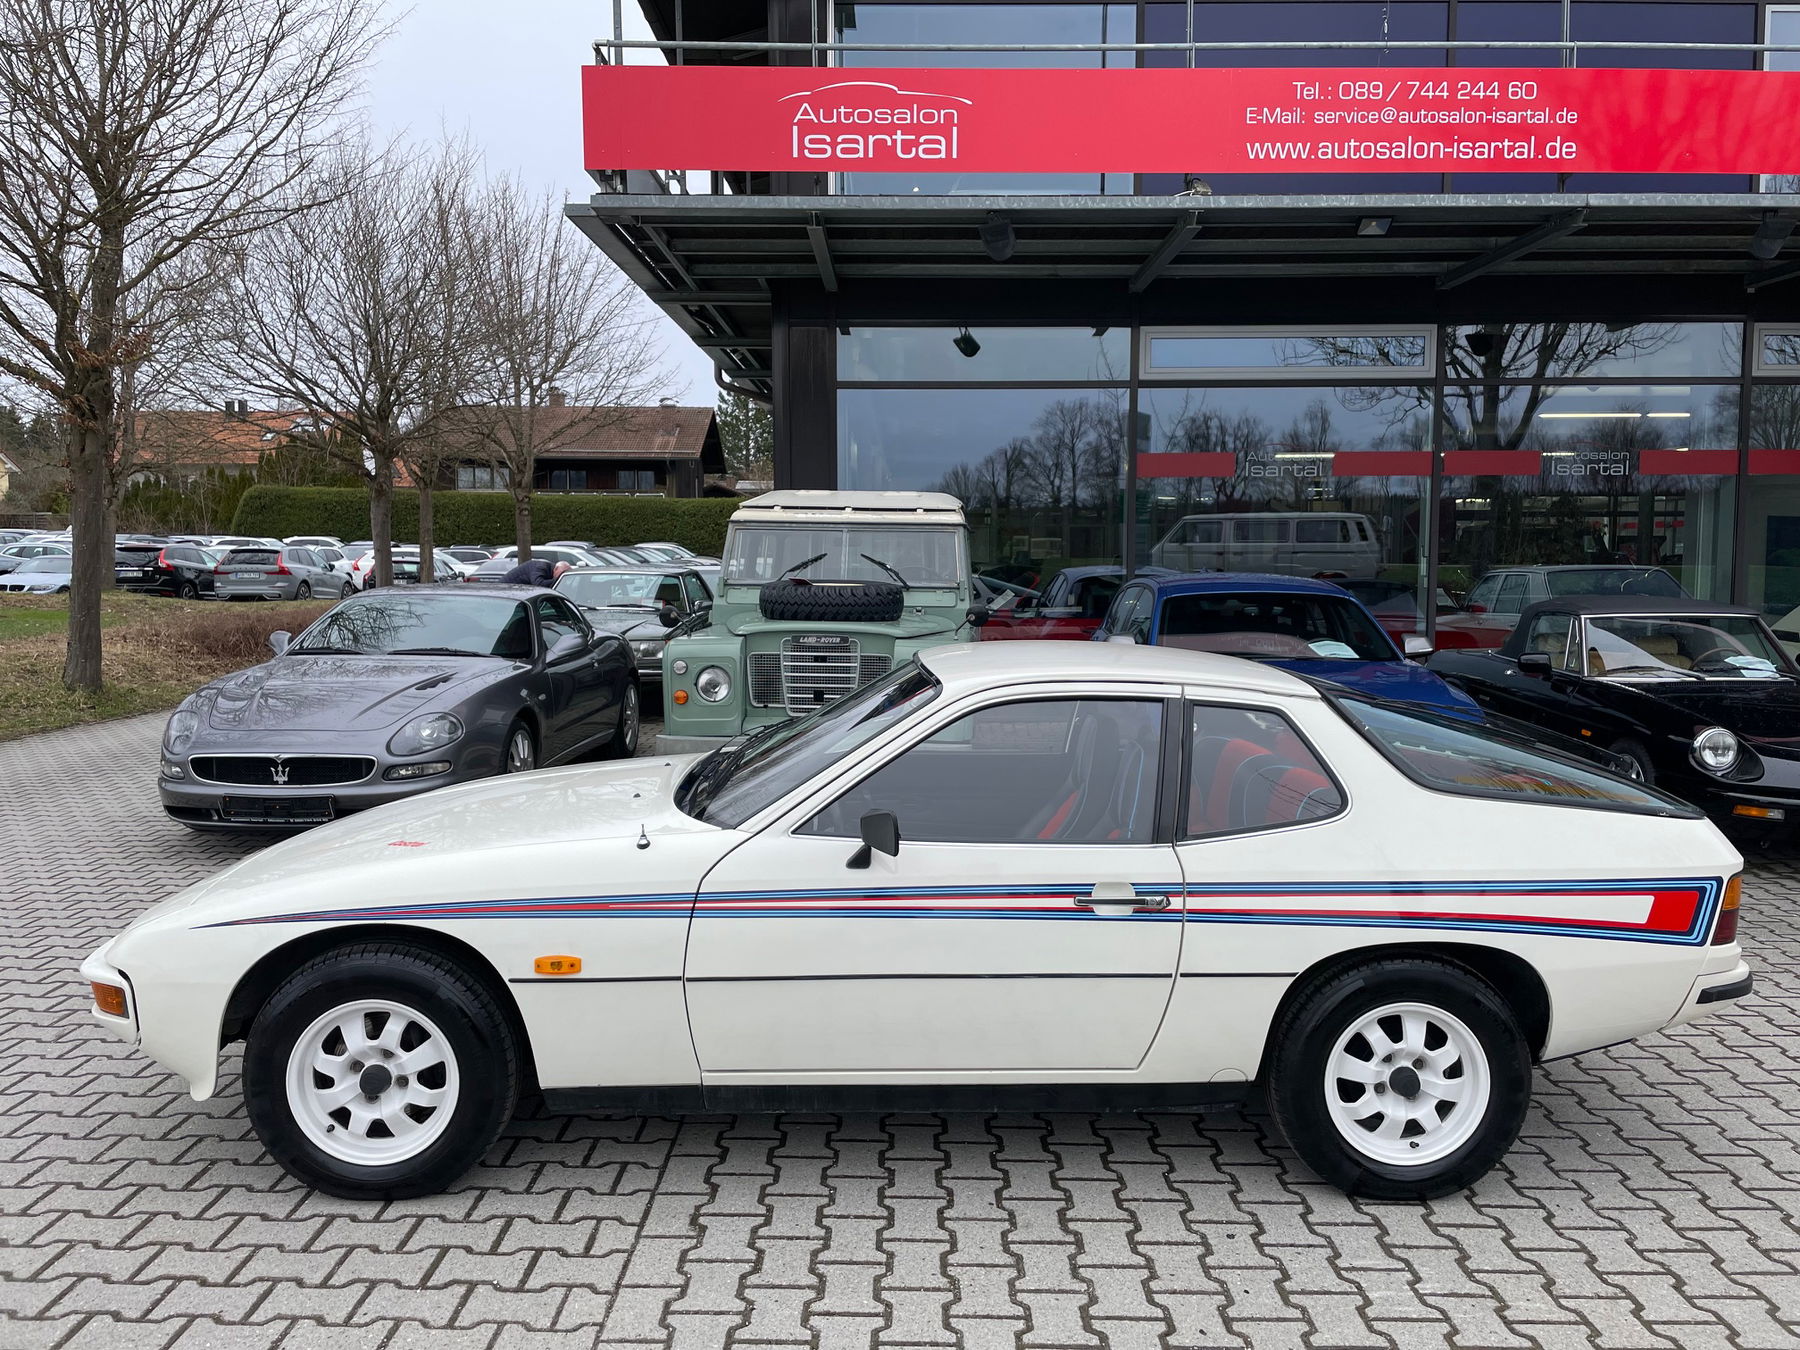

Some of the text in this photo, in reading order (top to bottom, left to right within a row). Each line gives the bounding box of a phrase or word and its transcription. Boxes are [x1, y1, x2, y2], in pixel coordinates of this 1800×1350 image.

[1457, 81, 1500, 100] 244
[1508, 81, 1538, 100] 60
[794, 102, 957, 124] Autosalon
[1246, 106, 1578, 124] E-Mail: service@autosalon-isartal.de
[793, 125, 958, 159] Isartal
[1246, 135, 1577, 160] www.autosalon-isartal.de
[1245, 461, 1323, 477] Isartal
[1551, 459, 1630, 475] Isartal
